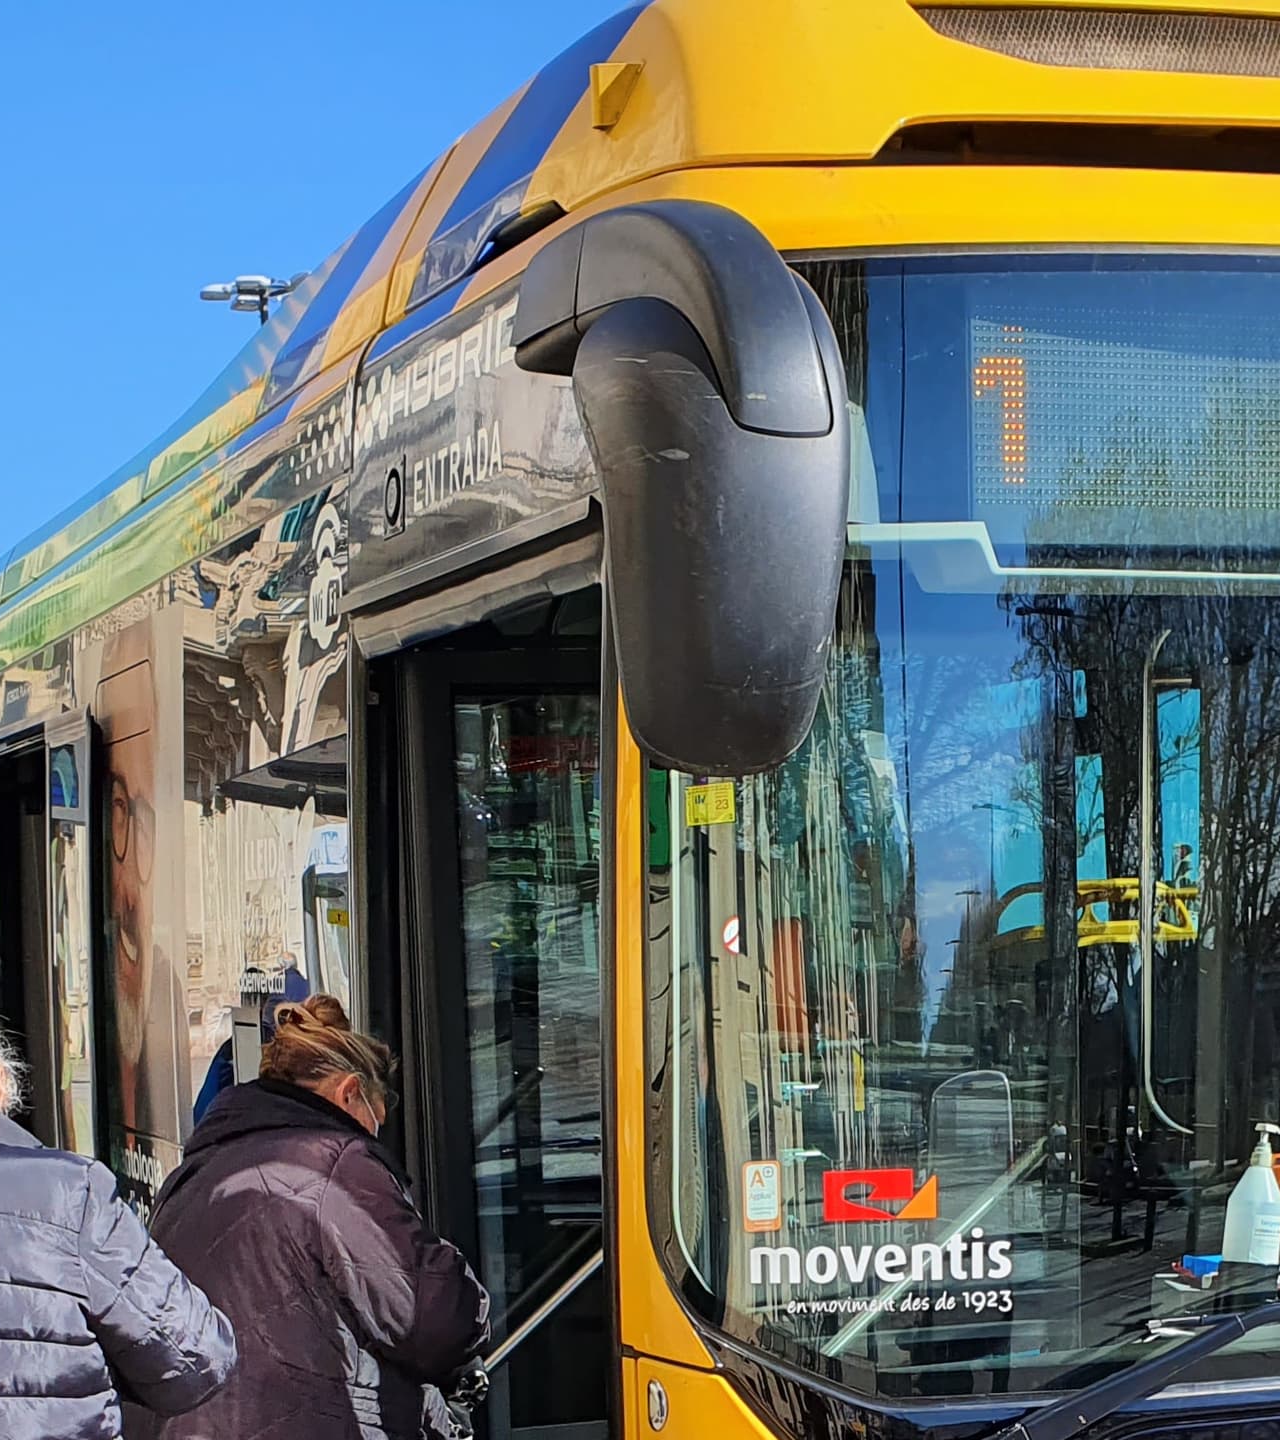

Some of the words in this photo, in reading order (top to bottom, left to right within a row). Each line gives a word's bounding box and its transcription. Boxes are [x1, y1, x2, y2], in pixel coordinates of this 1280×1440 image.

[973, 324, 1025, 485] 1
[413, 420, 503, 514] ENTRADA
[749, 1227, 1013, 1284] moventis
[787, 1300, 808, 1313] en
[811, 1296, 895, 1314] moviment
[900, 1291, 930, 1313] des
[935, 1291, 956, 1311] de
[962, 1289, 1013, 1313] 1923
